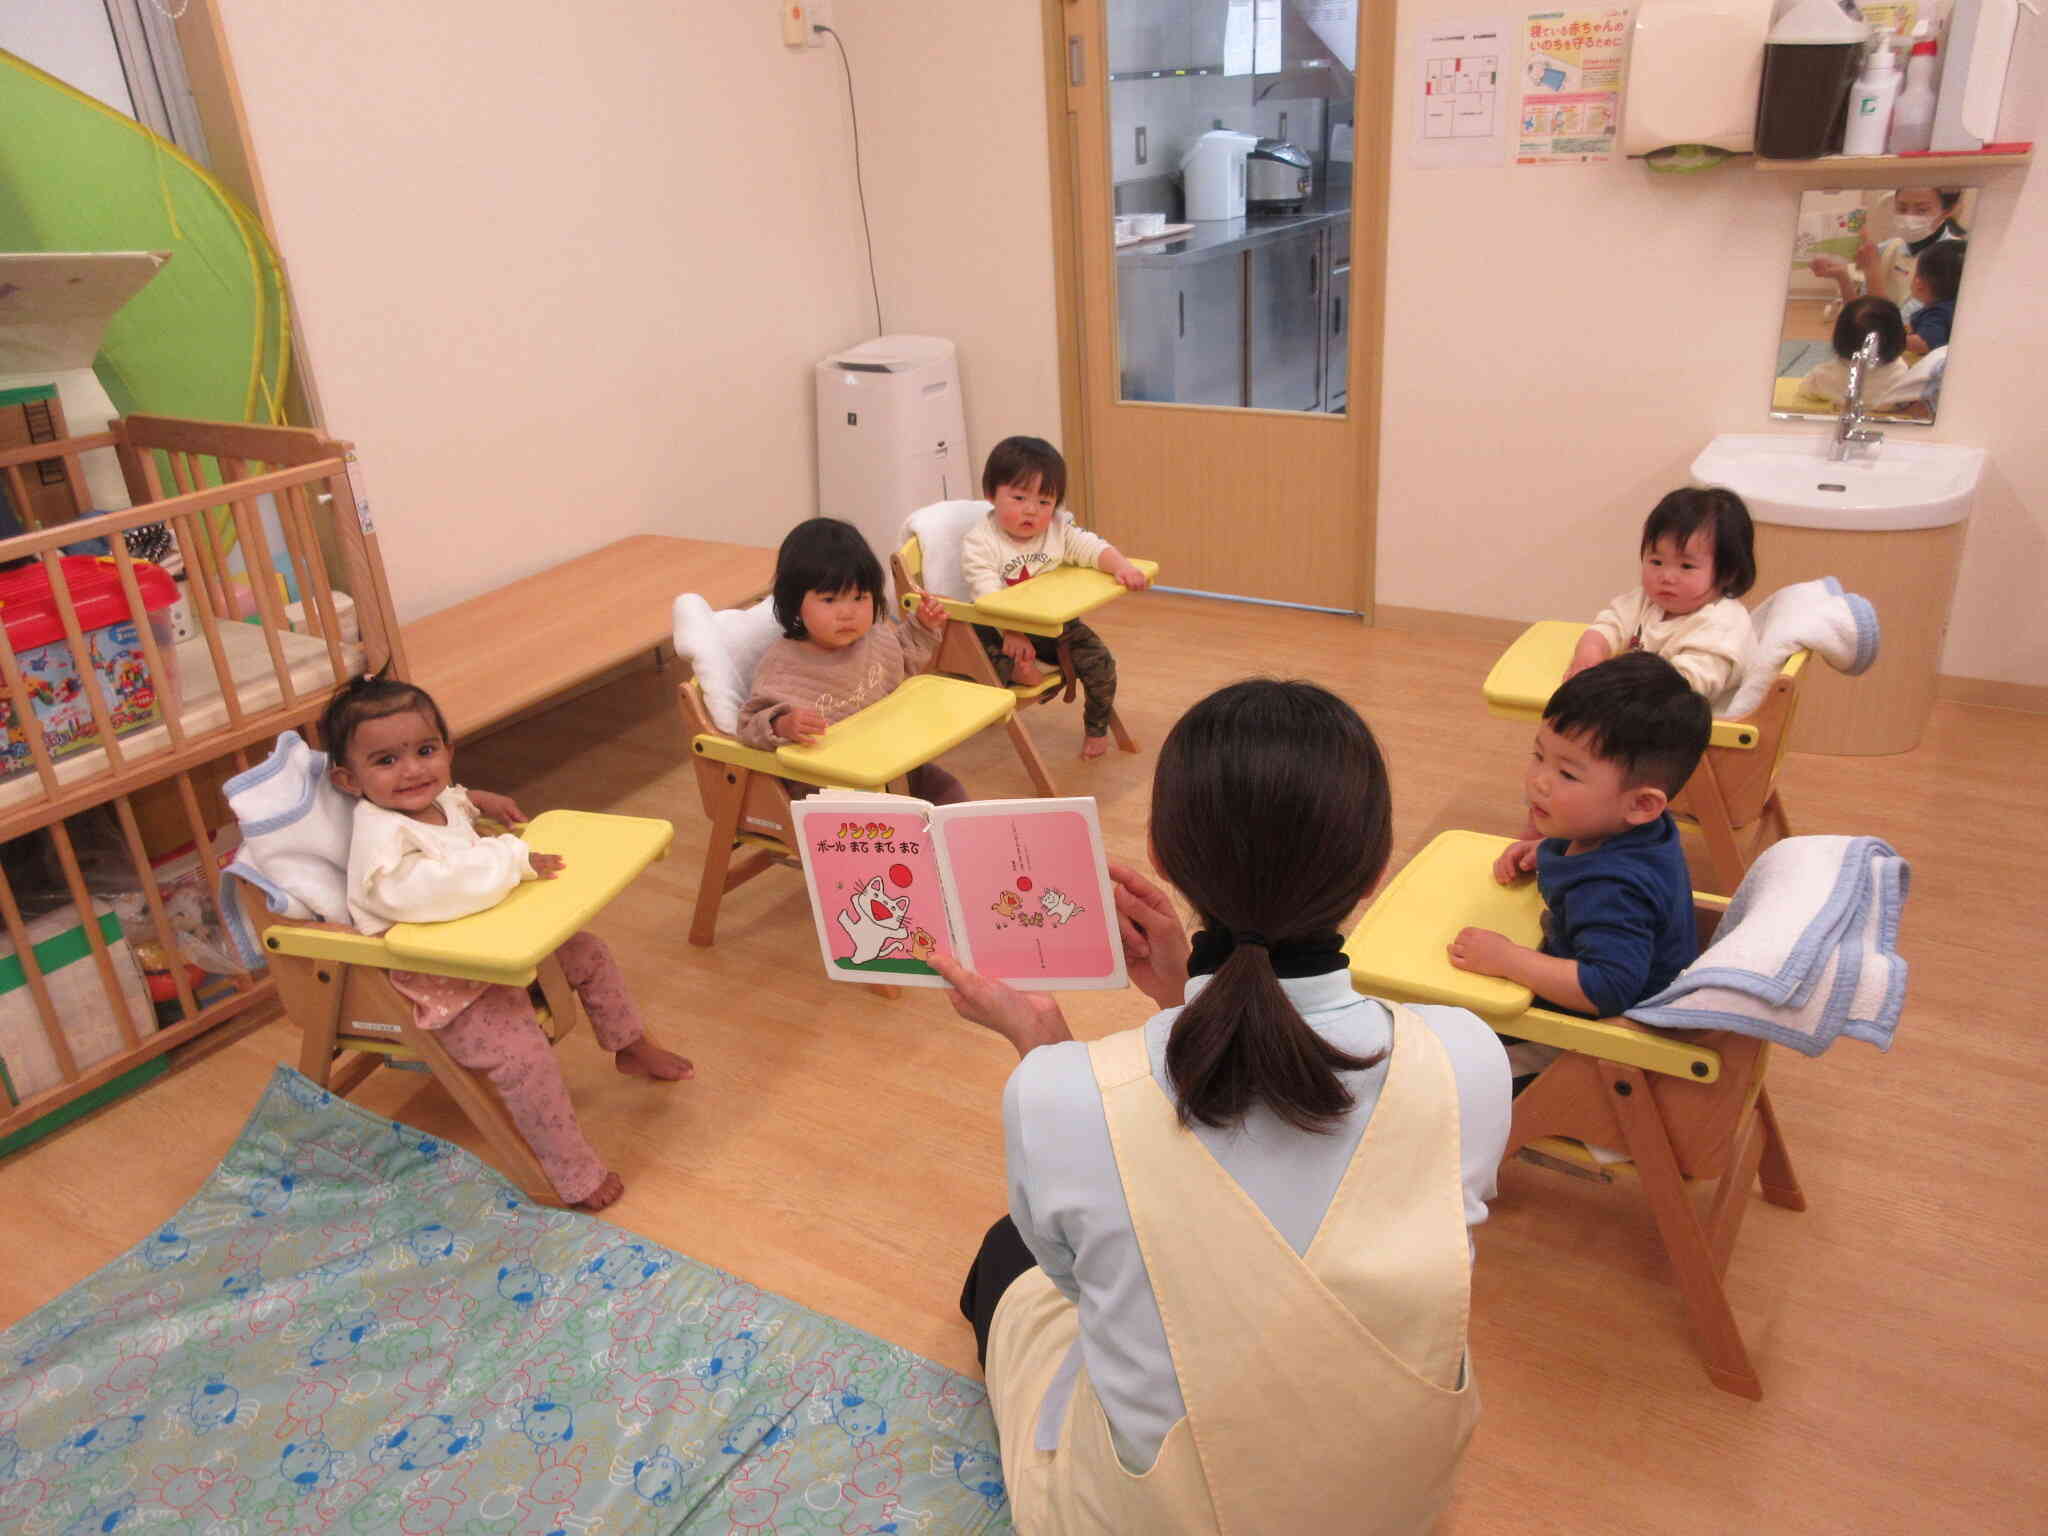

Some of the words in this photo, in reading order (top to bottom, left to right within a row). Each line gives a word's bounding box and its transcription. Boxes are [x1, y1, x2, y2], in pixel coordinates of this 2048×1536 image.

[1528, 21, 1624, 38] 寝ている赤ちゃんの
[1529, 37, 1625, 51] いのちを守るために
[837, 822, 895, 839] ノンタン
[817, 840, 846, 853] ボール
